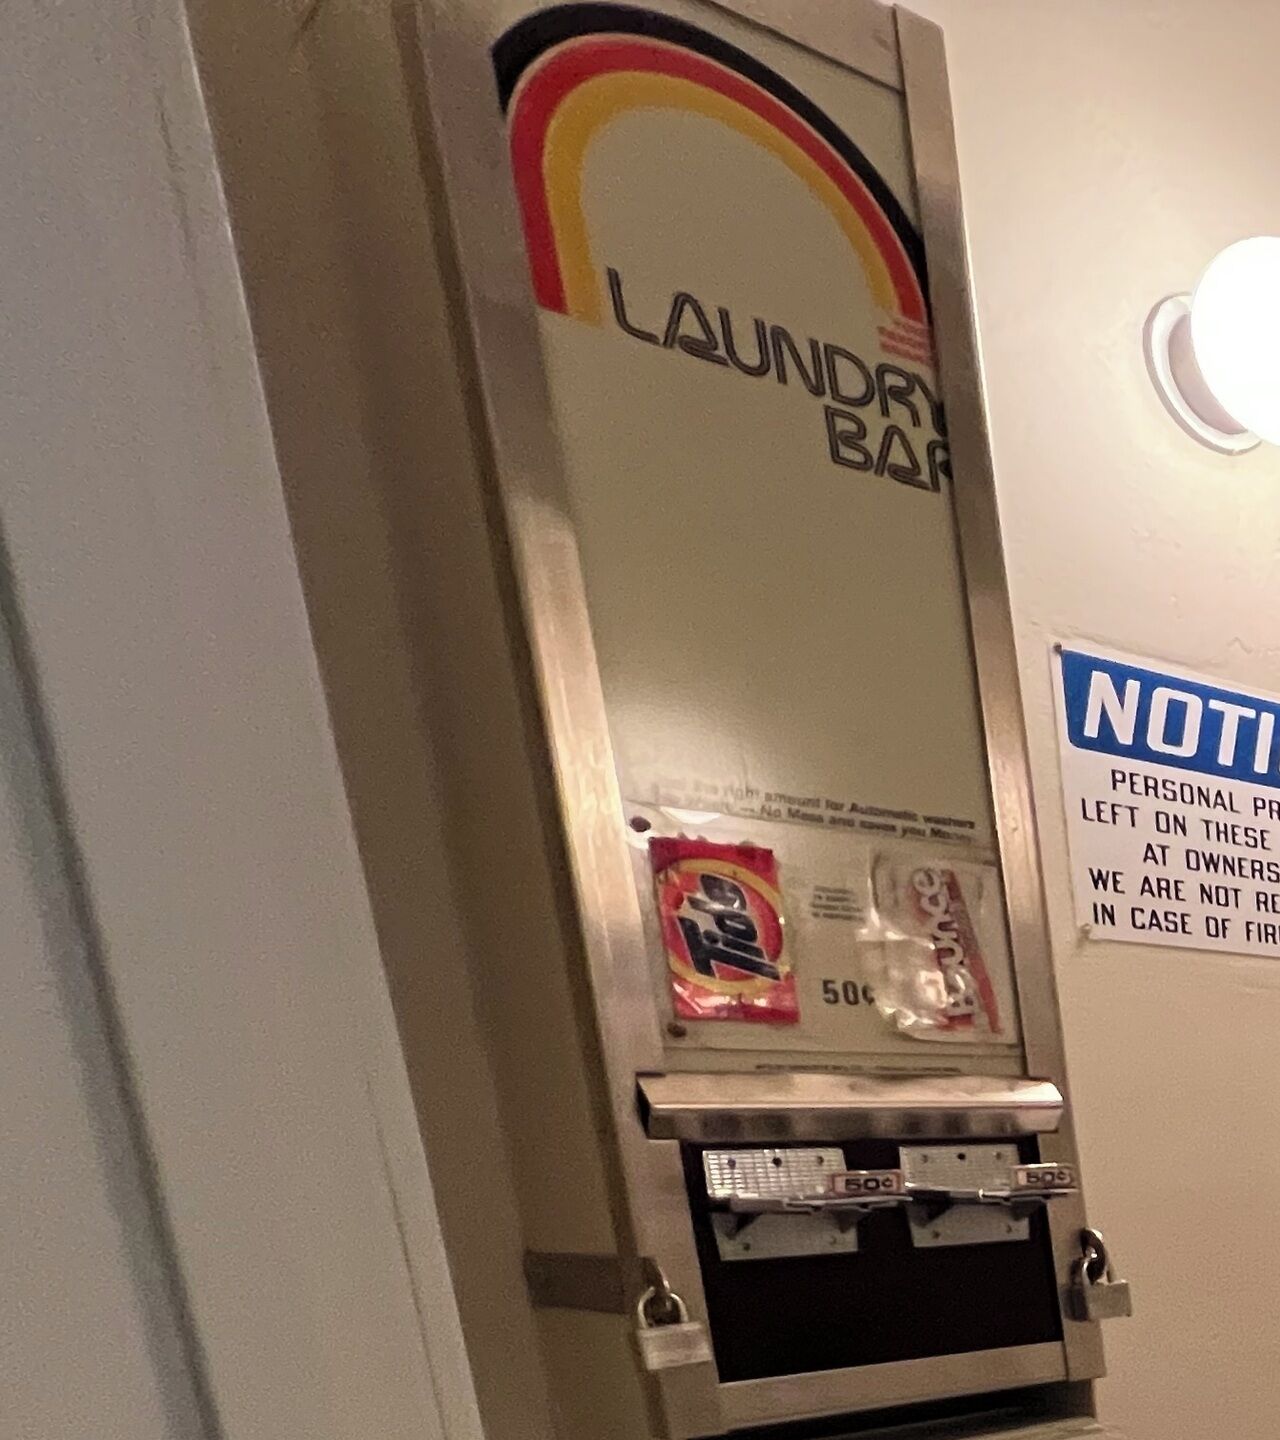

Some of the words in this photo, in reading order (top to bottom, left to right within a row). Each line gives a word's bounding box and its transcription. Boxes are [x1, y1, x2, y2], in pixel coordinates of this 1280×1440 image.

[606, 266, 949, 438] LAUNDRY
[760, 804, 782, 818] No
[1110, 768, 1241, 814] PERSONAL
[1081, 797, 1140, 828] LEFT
[1155, 811, 1187, 837] ON
[1200, 817, 1271, 851] THESE
[1142, 842, 1171, 867] AT
[1185, 849, 1280, 884] OWNERS
[1088, 867, 1125, 895] WE
[1139, 875, 1186, 901] ARE
[1199, 882, 1242, 910] NOT
[677, 873, 781, 981] Tide
[1092, 902, 1116, 926] IN
[1130, 906, 1193, 935] CASE
[1205, 915, 1231, 940] OF
